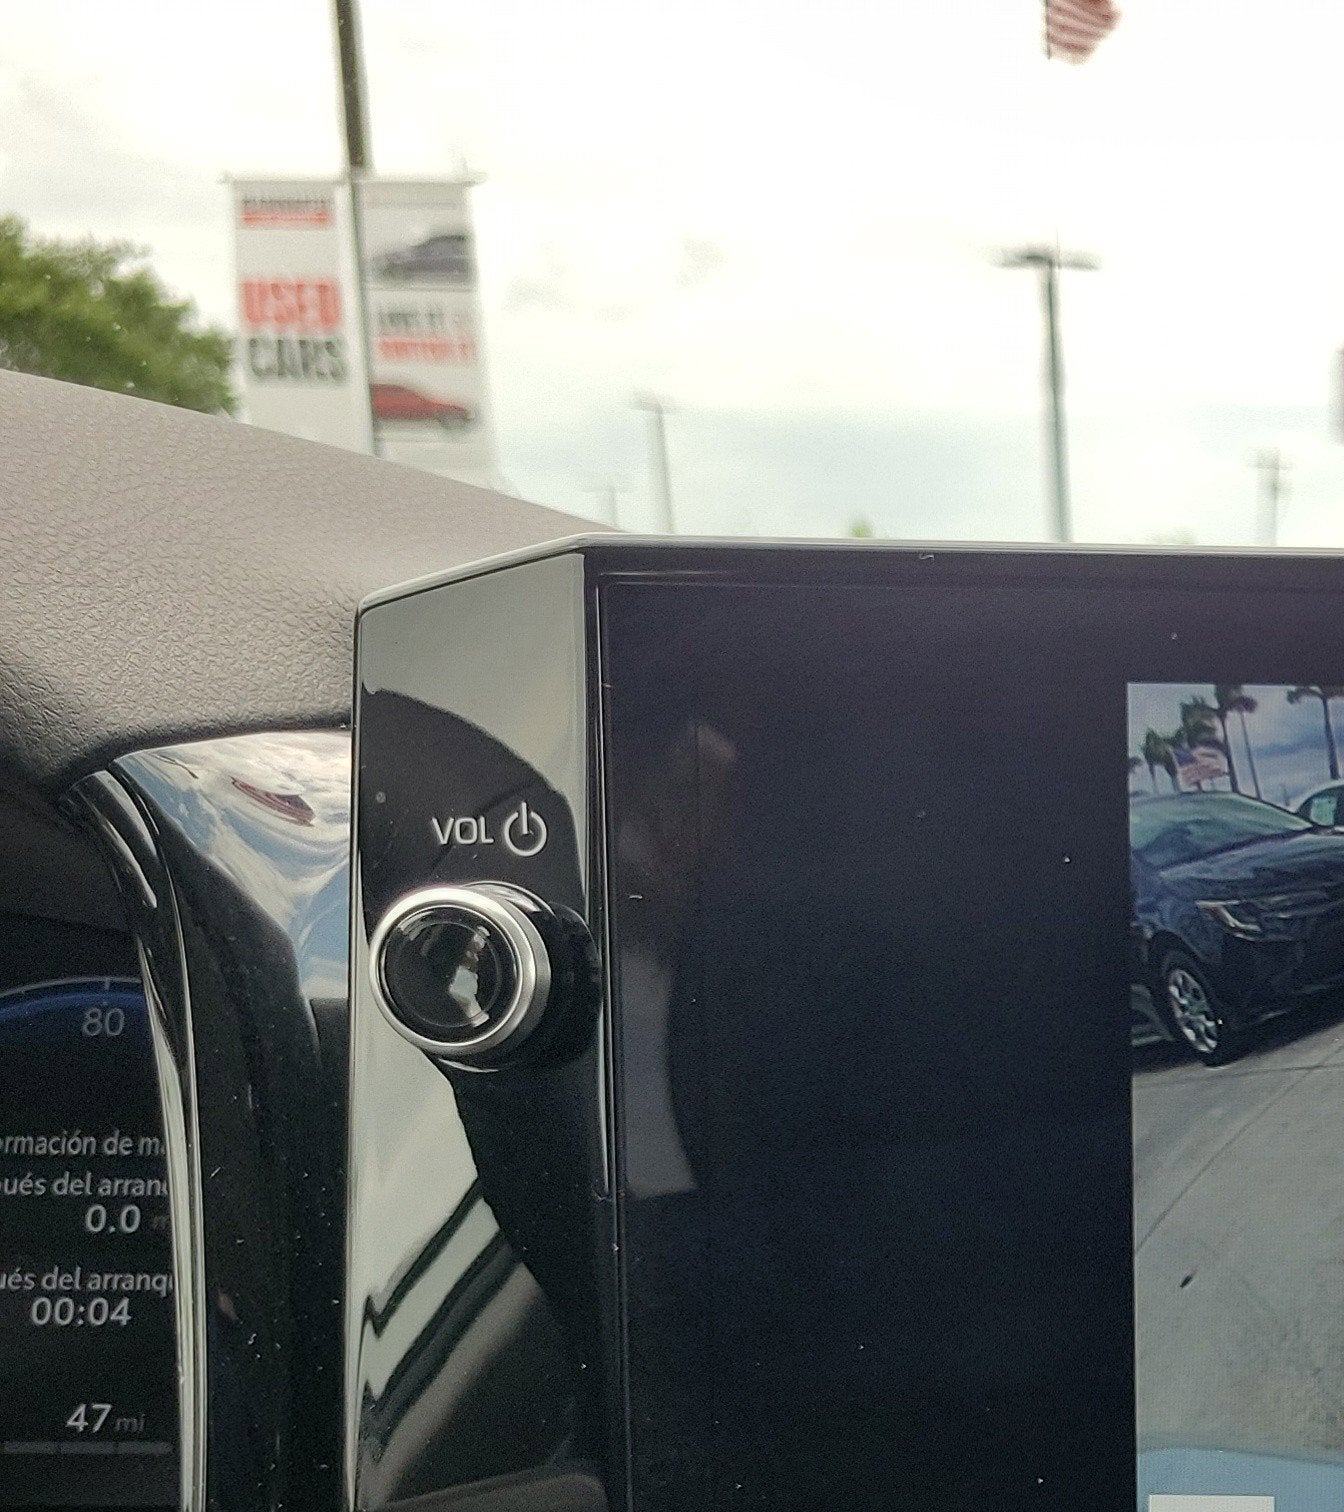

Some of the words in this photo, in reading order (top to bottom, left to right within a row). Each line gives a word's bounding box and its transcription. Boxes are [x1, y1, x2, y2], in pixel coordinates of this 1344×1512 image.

[432, 816, 494, 845] VOL
[81, 1008, 125, 1036] 80
[103, 1129, 133, 1155] de
[0, 1172, 47, 1195] ués
[53, 1171, 92, 1196] del
[85, 1204, 141, 1233] 0.0
[41, 1265, 81, 1290] del
[31, 1297, 132, 1326] 00:04
[65, 1403, 113, 1433] 47
